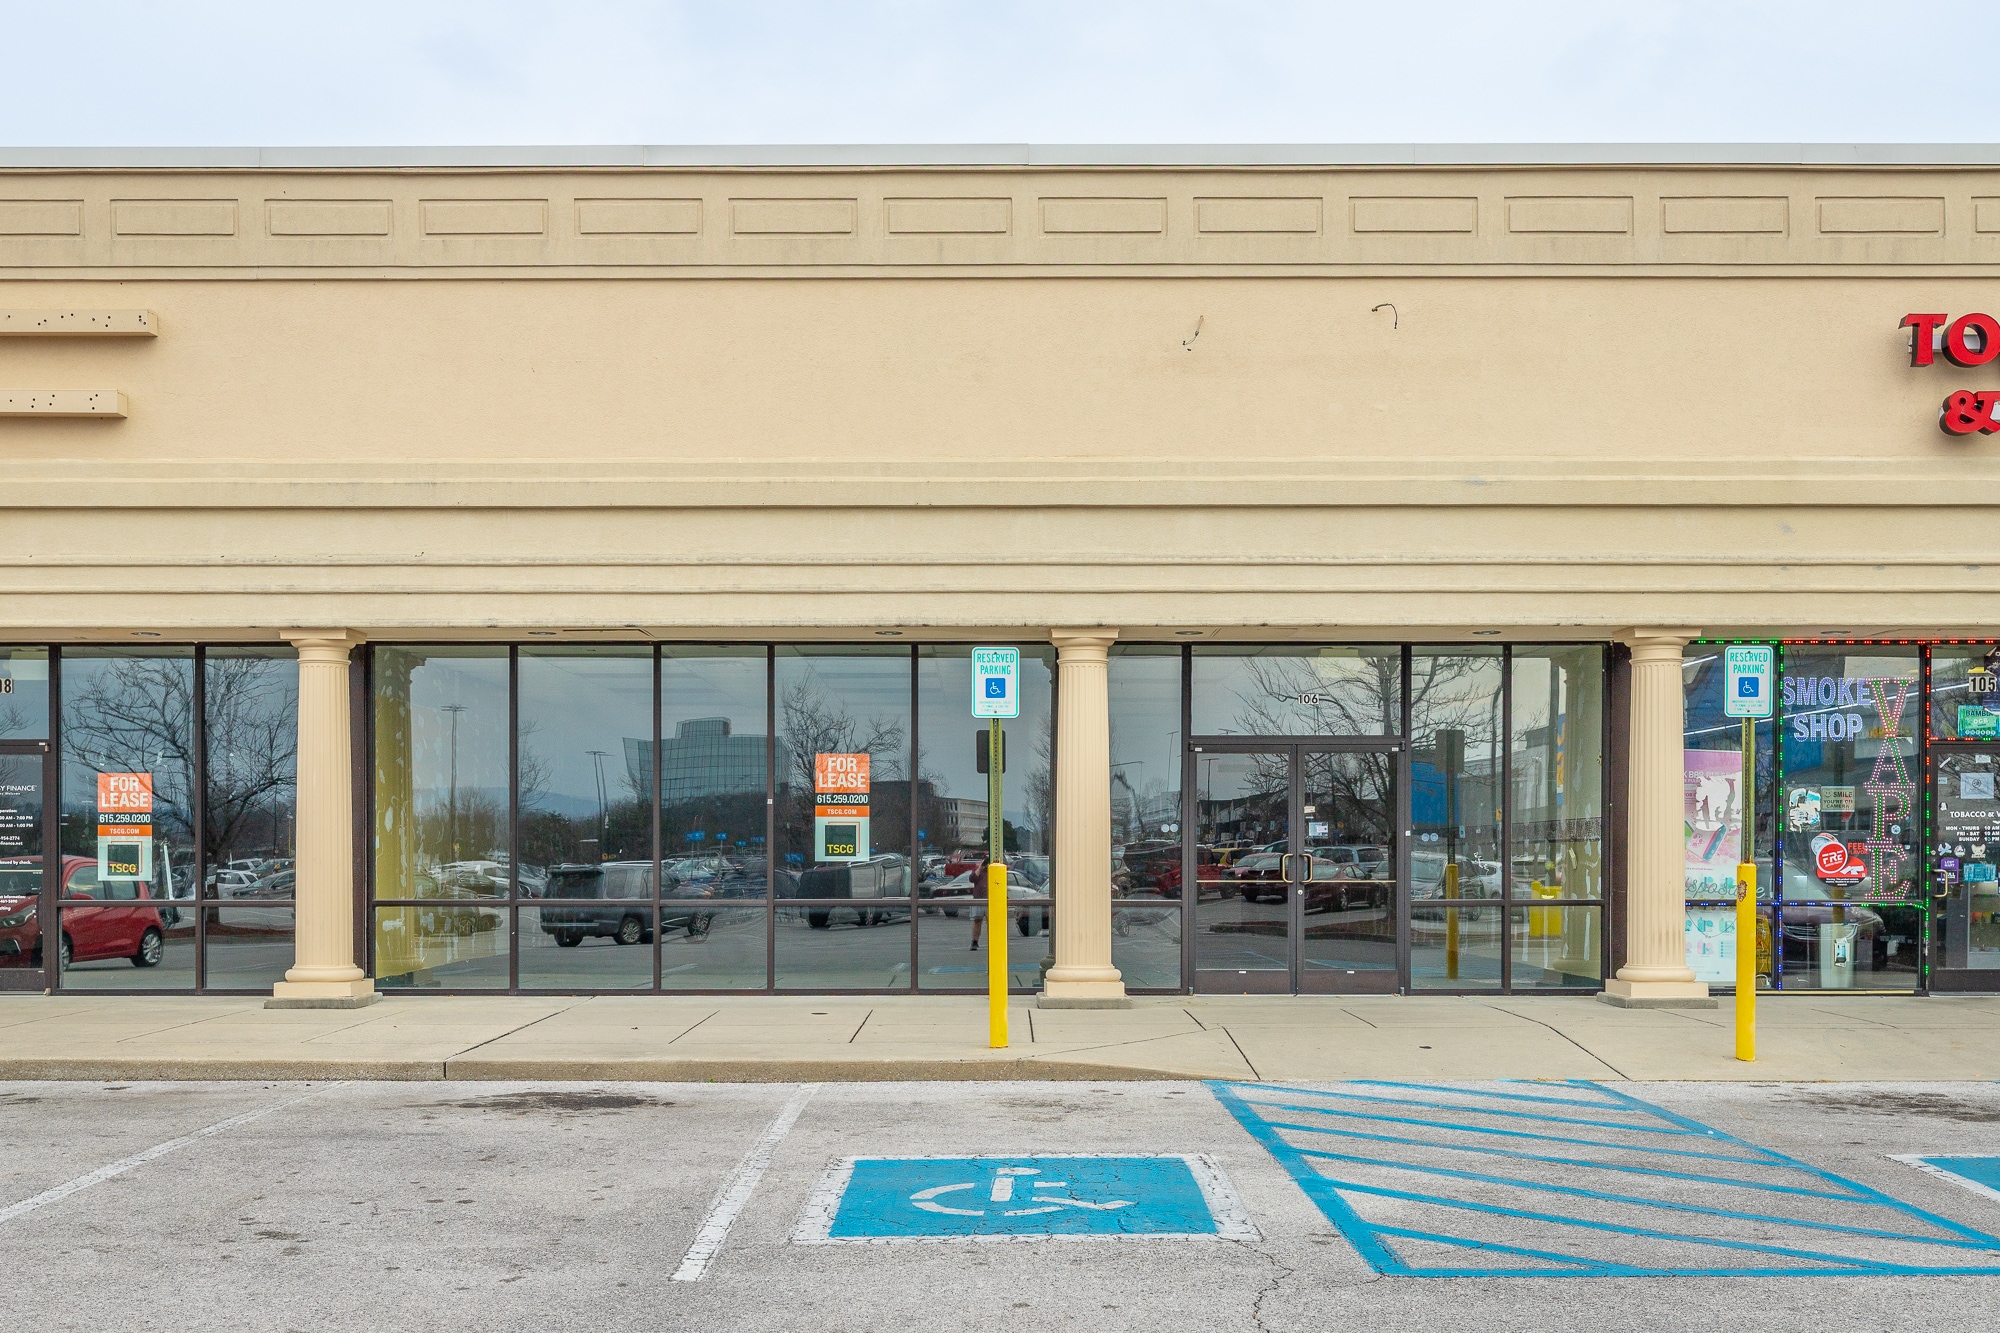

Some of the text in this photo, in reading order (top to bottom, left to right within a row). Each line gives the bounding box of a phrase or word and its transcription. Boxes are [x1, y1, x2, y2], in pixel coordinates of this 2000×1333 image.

[1899, 313, 2000, 367] TO
[977, 653, 1014, 663] RESERVED
[1730, 652, 1768, 662] RESERVED
[980, 665, 1011, 675] PARKING
[1733, 664, 1765, 674] PARKING
[1783, 677, 1872, 706] SMOKE
[1971, 677, 1996, 692] 105
[1299, 694, 1318, 704] 106
[1793, 713, 1863, 742] SHOP
[828, 757, 857, 773] FOR
[110, 776, 139, 792] FOR
[819, 773, 866, 788] LEASE
[1864, 676, 1915, 900] VAPE
[101, 792, 149, 808] LEASE
[817, 794, 868, 804] 615.259.0200
[100, 814, 150, 823] 615.259.0200
[827, 844, 853, 854] TSCG
[1822, 850, 1844, 865] FRE
[110, 863, 137, 873] TSCG
